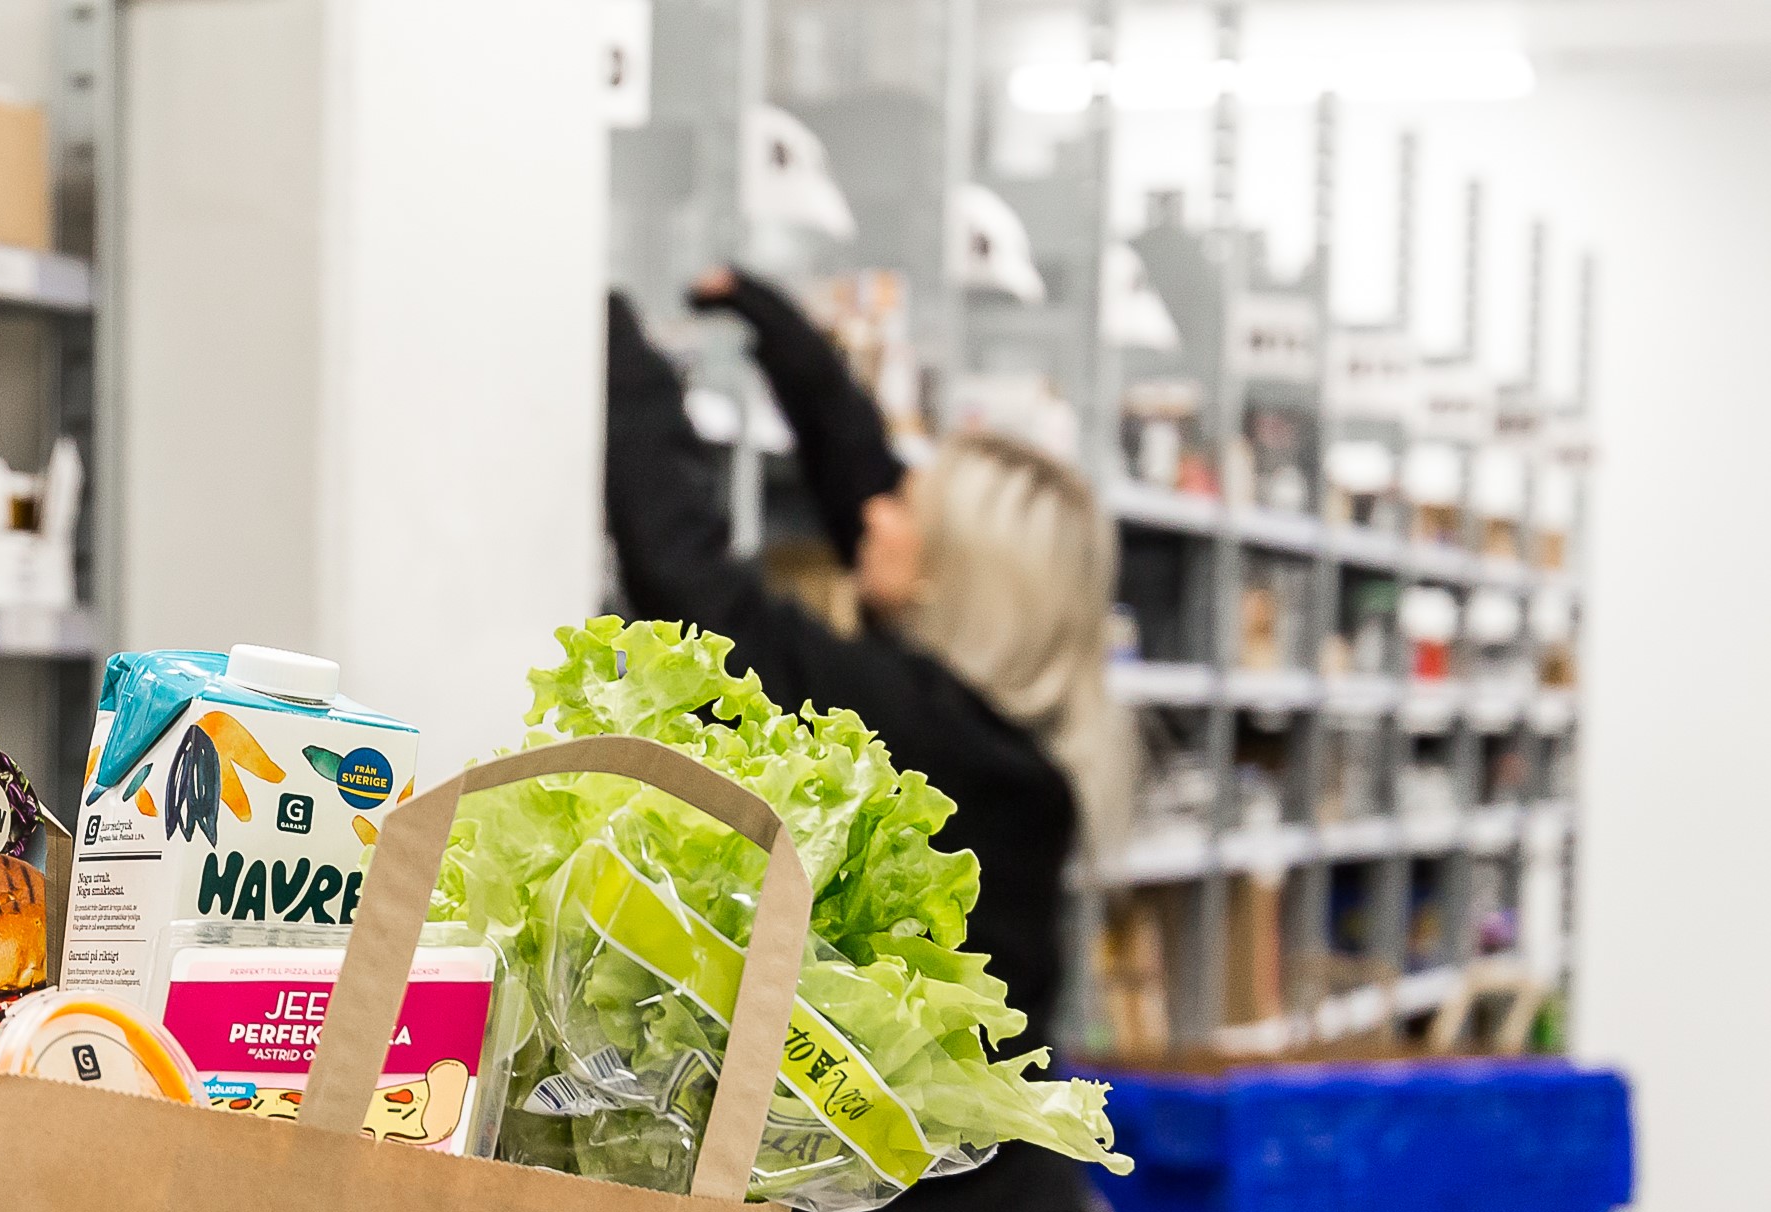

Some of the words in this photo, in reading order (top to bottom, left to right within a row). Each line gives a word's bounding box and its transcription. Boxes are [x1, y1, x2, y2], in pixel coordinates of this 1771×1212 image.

[354, 764, 377, 775] FRÅN
[341, 772, 388, 788] SVERIGE
[286, 799, 305, 821] G
[280, 822, 307, 831] GARANT
[267, 967, 283, 976] TILL
[312, 967, 341, 977] LASAG
[410, 967, 440, 976] ACKOR
[264, 990, 330, 1021] JEE
[229, 1022, 324, 1046] PERFEK
